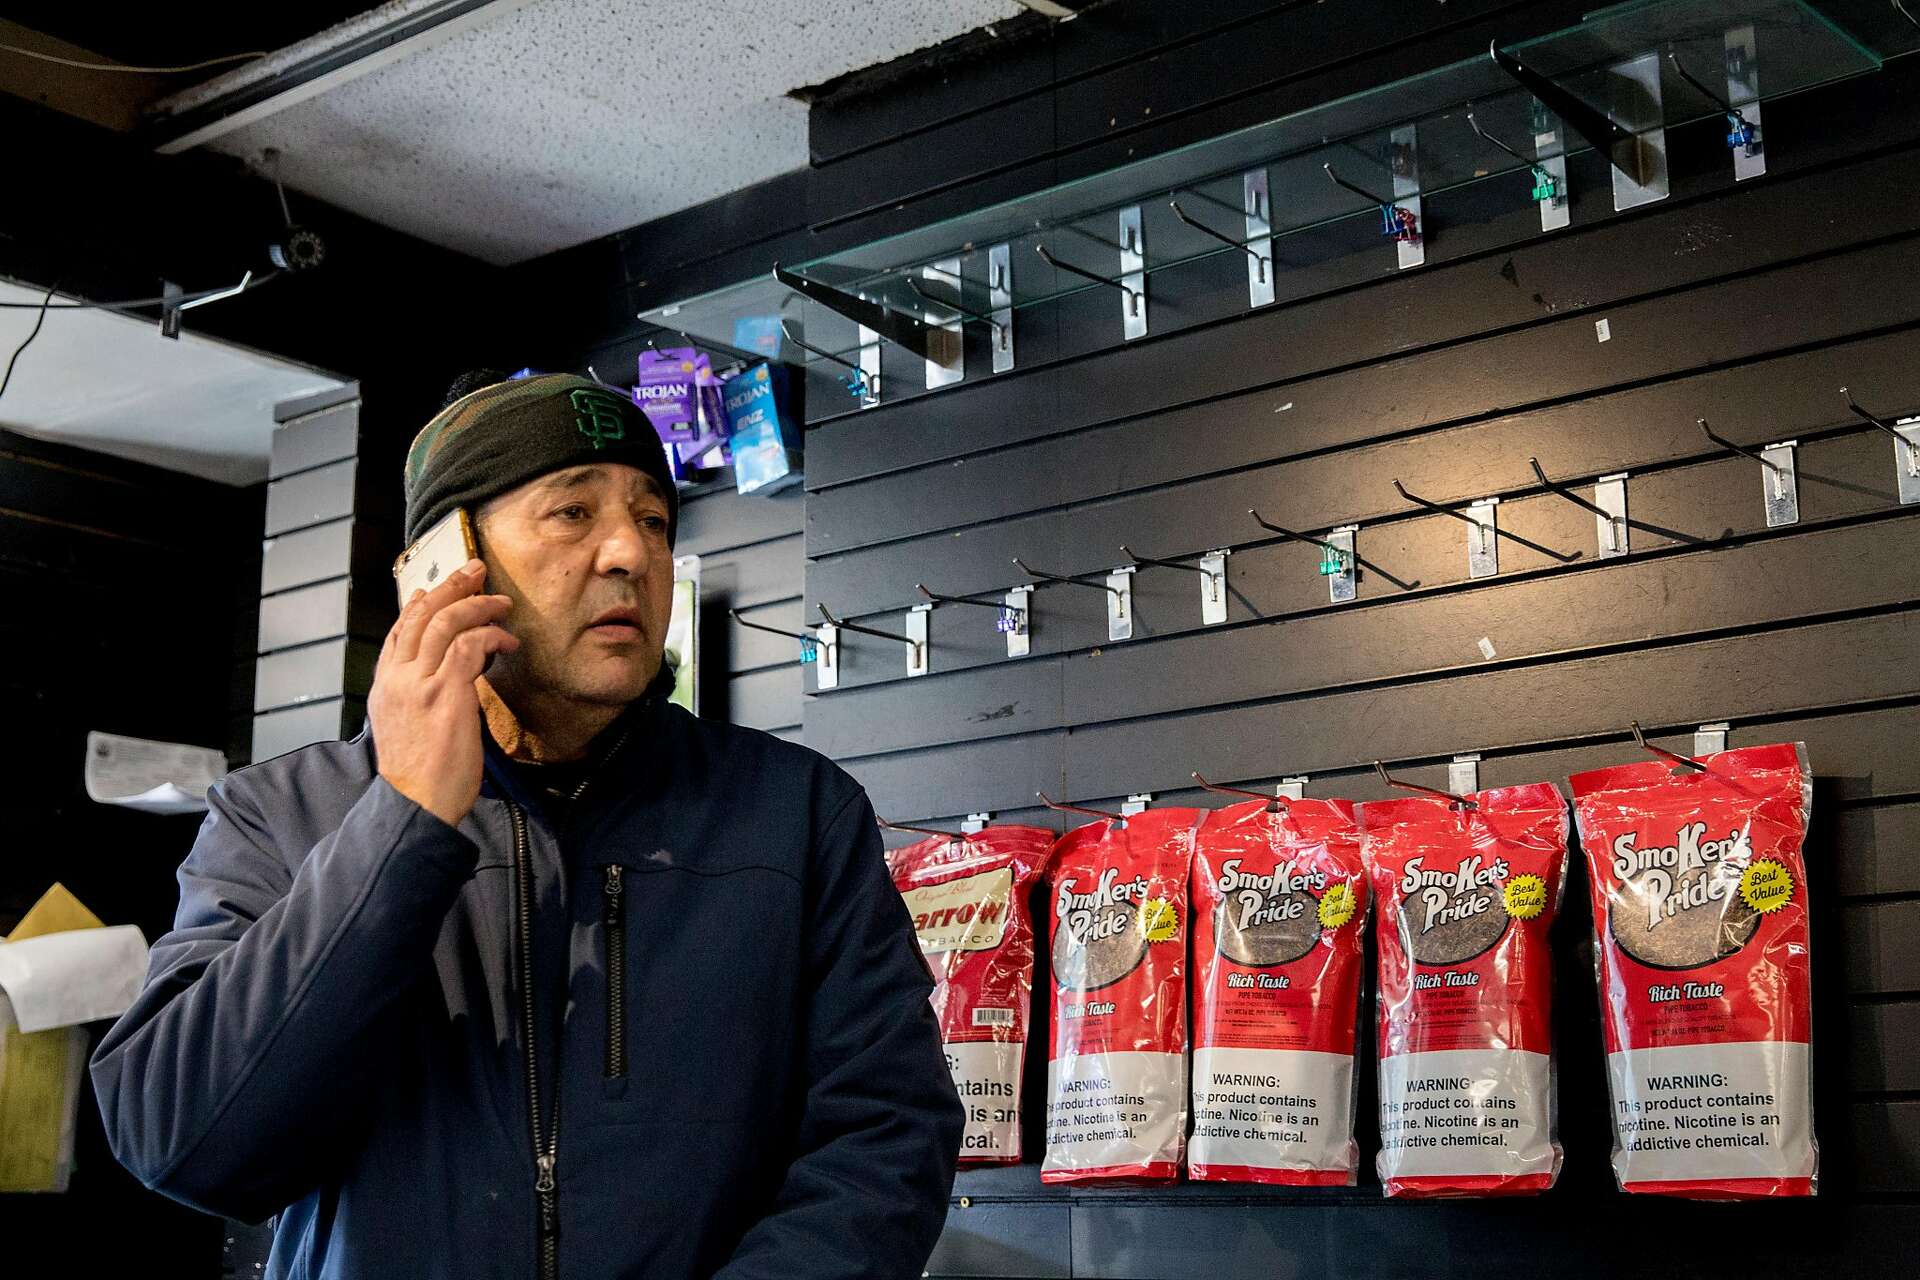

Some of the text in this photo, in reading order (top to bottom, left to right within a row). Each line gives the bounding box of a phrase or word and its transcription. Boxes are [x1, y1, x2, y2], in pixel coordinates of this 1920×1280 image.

[632, 384, 688, 400] TROJAN
[1750, 869, 1779, 886] Best
[1512, 882, 1536, 897] Best
[1750, 884, 1785, 901] Value
[1509, 895, 1542, 908] Value
[1645, 868, 1726, 932] Pride
[913, 901, 1006, 931] arrow
[1238, 889, 1304, 932] Pride
[1421, 886, 1491, 935] Pride
[1070, 909, 1127, 946] Pride
[1227, 972, 1290, 989] Rich Taste
[1414, 971, 1479, 990] Rich Taste
[1648, 982, 1724, 1003] Rich Taste
[1087, 1001, 1116, 1016] Taste
[955, 1078, 1013, 1096] ntains
[1213, 1073, 1280, 1088] WARNING:
[1647, 1074, 1728, 1091] WARNING:
[1056, 1098, 1093, 1113] product
[1096, 1093, 1145, 1107] contains
[1207, 1092, 1256, 1104] product
[1259, 1095, 1317, 1109] contains
[1403, 1097, 1450, 1114] product
[1619, 1093, 1774, 1113] This product contains
[970, 1105, 1016, 1123] is an
[1074, 1112, 1114, 1125] Nicotine
[1117, 1111, 1127, 1121] is
[1131, 1113, 1147, 1122] an
[1287, 1113, 1298, 1125] is
[1302, 1115, 1319, 1127] an
[1424, 1115, 1478, 1128] Nicotine
[1484, 1114, 1497, 1127] is
[1501, 1118, 1519, 1128] an
[1619, 1113, 1780, 1133] nicotine. Nicotine is an
[1087, 1127, 1137, 1142] chemical.
[1193, 1125, 1307, 1143] ddictive chemical.
[1441, 1133, 1508, 1147] chemical.
[1627, 1132, 1769, 1151] addictive chemical.
